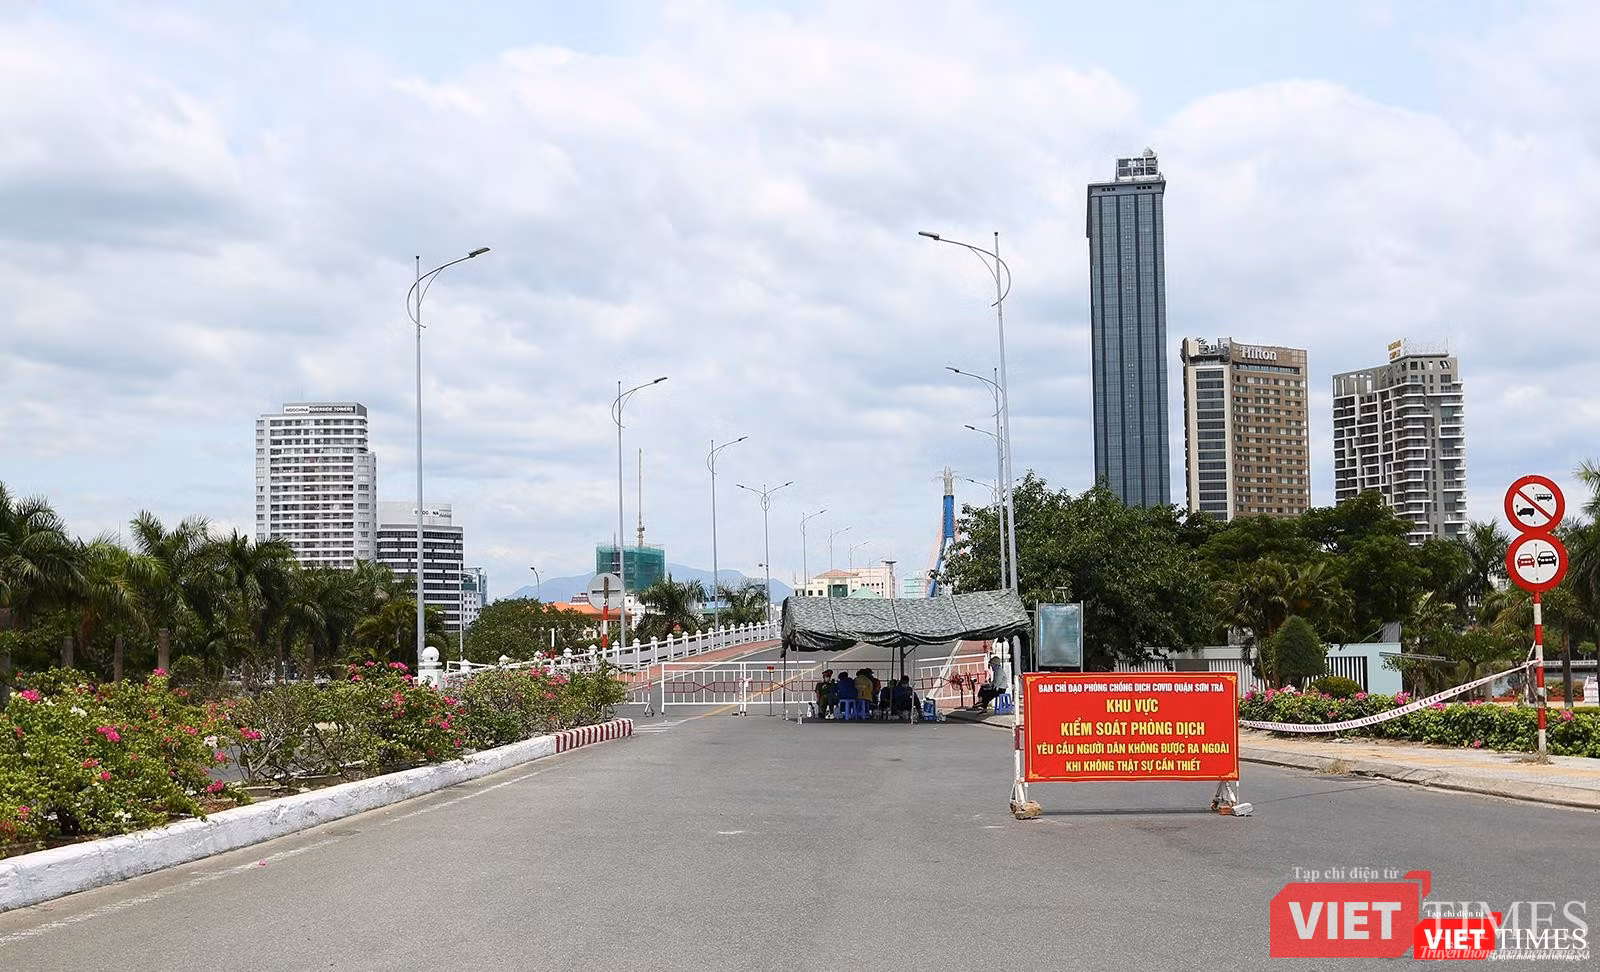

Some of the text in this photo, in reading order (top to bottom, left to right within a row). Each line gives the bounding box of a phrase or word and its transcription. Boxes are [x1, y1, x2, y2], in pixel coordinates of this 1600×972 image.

[1240, 345, 1277, 360] Hilton
[1039, 680, 1224, 694] BAN CHỈ ĐẠO PHÒNG CHỐNG DỊCH COVID QUẬN SƠN TRÀ
[1106, 698, 1159, 716] KHU VỰC
[1061, 717, 1205, 739] KIỂM SOÁT PHÒNG DỊCH
[1037, 742, 1054, 755] YÊU
[1077, 741, 1104, 754] NGƯỜI
[1107, 741, 1126, 754] DÂN
[1128, 741, 1158, 754] KHÔNG
[1161, 742, 1185, 756] ĐƯỢC
[1188, 743, 1200, 754] RA
[1202, 742, 1229, 754] NGOÀI
[1066, 761, 1081, 772] KHI
[1083, 759, 1114, 772] KHÔNG
[1117, 759, 1138, 774] THẬT
[1141, 760, 1155, 773] SỰ
[1177, 758, 1201, 771] THIẾT
